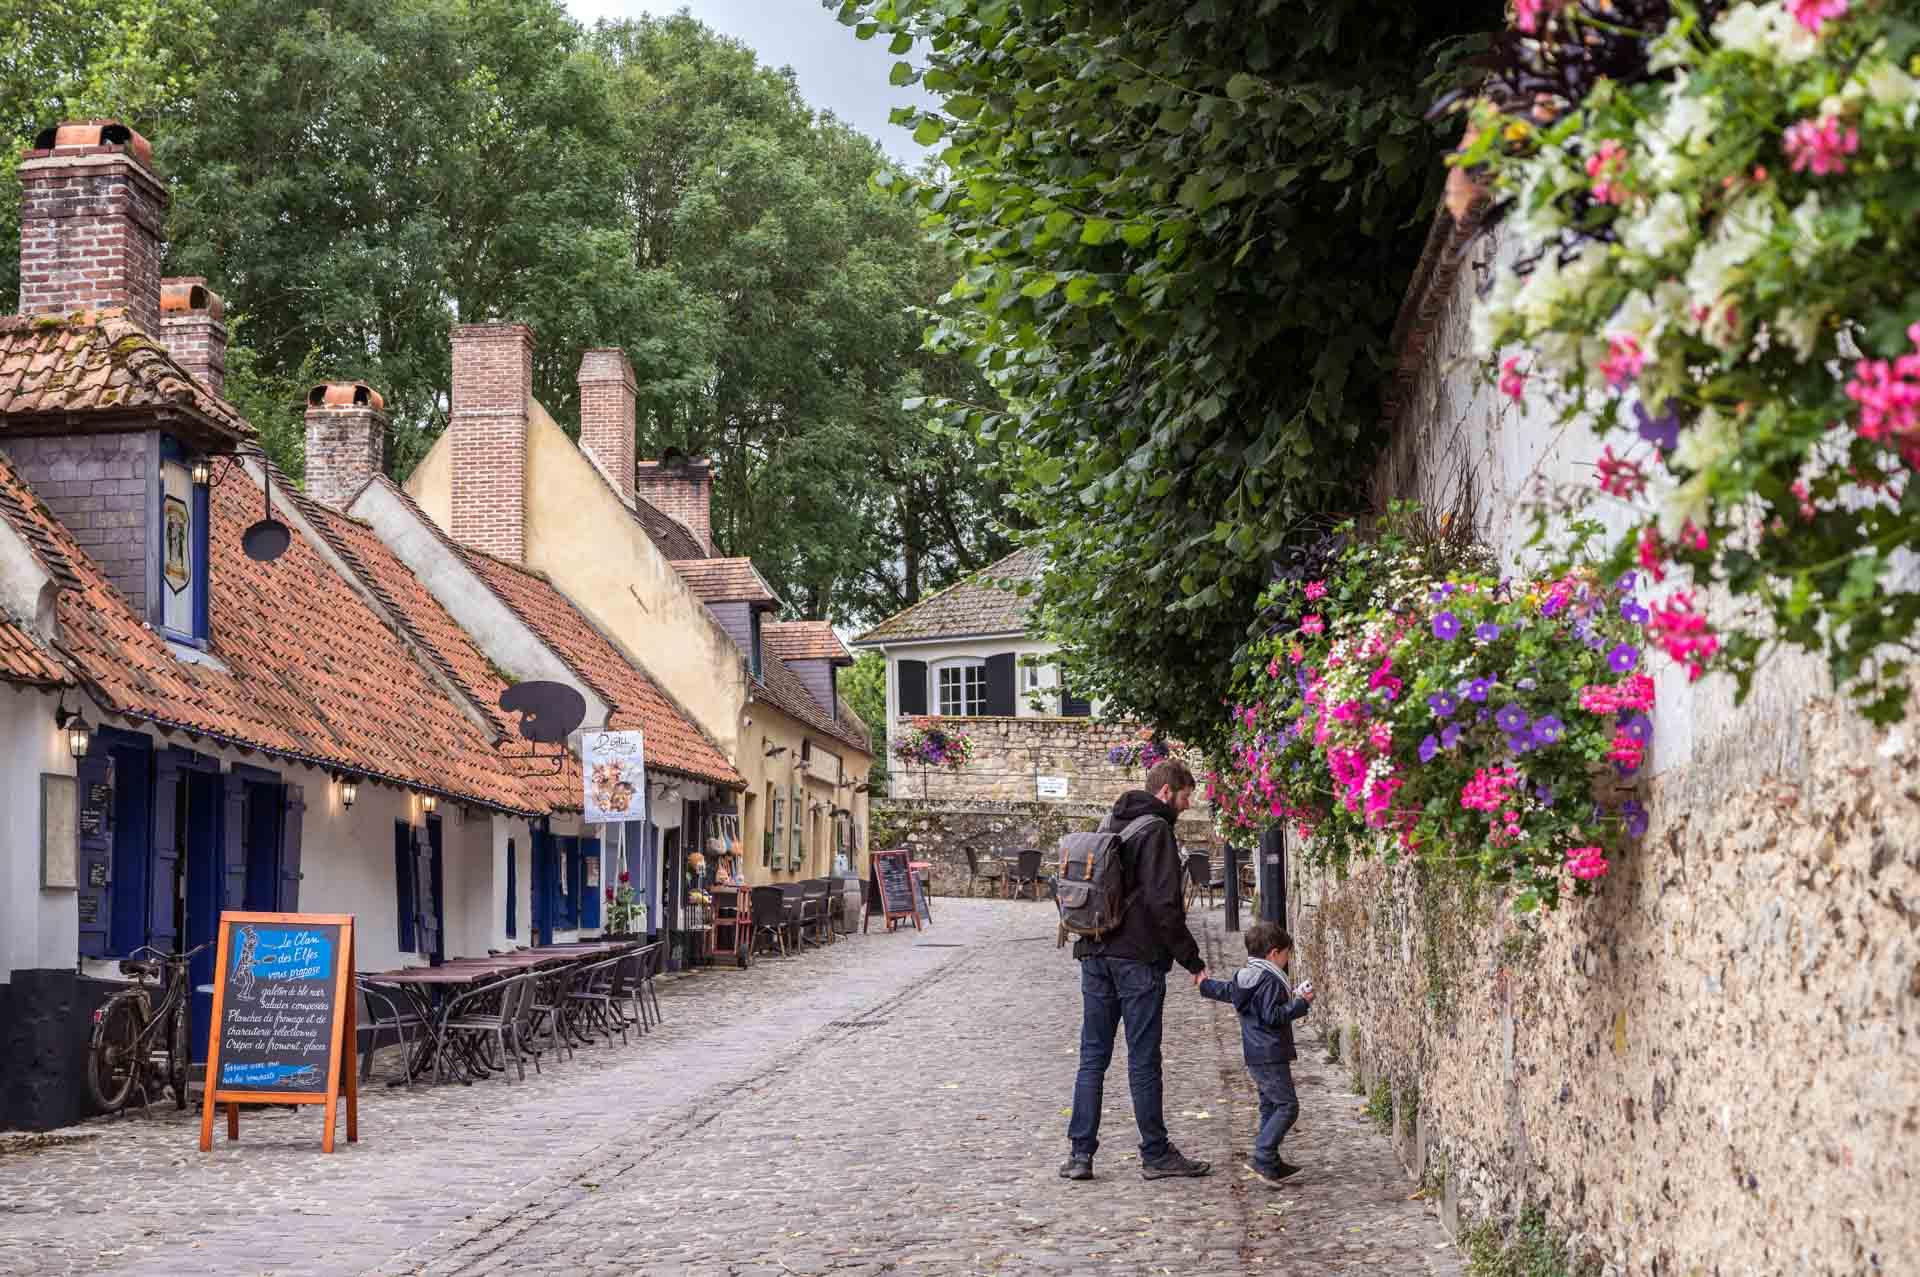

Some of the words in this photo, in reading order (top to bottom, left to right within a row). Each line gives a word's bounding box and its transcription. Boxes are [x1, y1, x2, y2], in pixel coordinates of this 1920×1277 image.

[278, 932, 291, 948] Le
[293, 931, 320, 946] Clan
[278, 952, 291, 963] des
[294, 947, 319, 966] Elfes
[268, 970, 287, 980] vous
[289, 966, 320, 979] propose
[288, 986, 296, 996] de
[260, 998, 289, 1009] Salades
[291, 1001, 329, 1011] composées
[228, 1009, 262, 1023] Planches
[263, 1012, 273, 1022] de
[273, 1011, 304, 1030] fromage
[306, 1014, 315, 1023] et
[316, 1014, 326, 1024] de
[227, 1025, 272, 1036] charcuterie
[226, 1038, 252, 1053] Crêpes
[255, 1040, 265, 1050] de
[303, 1039, 327, 1057] glaces
